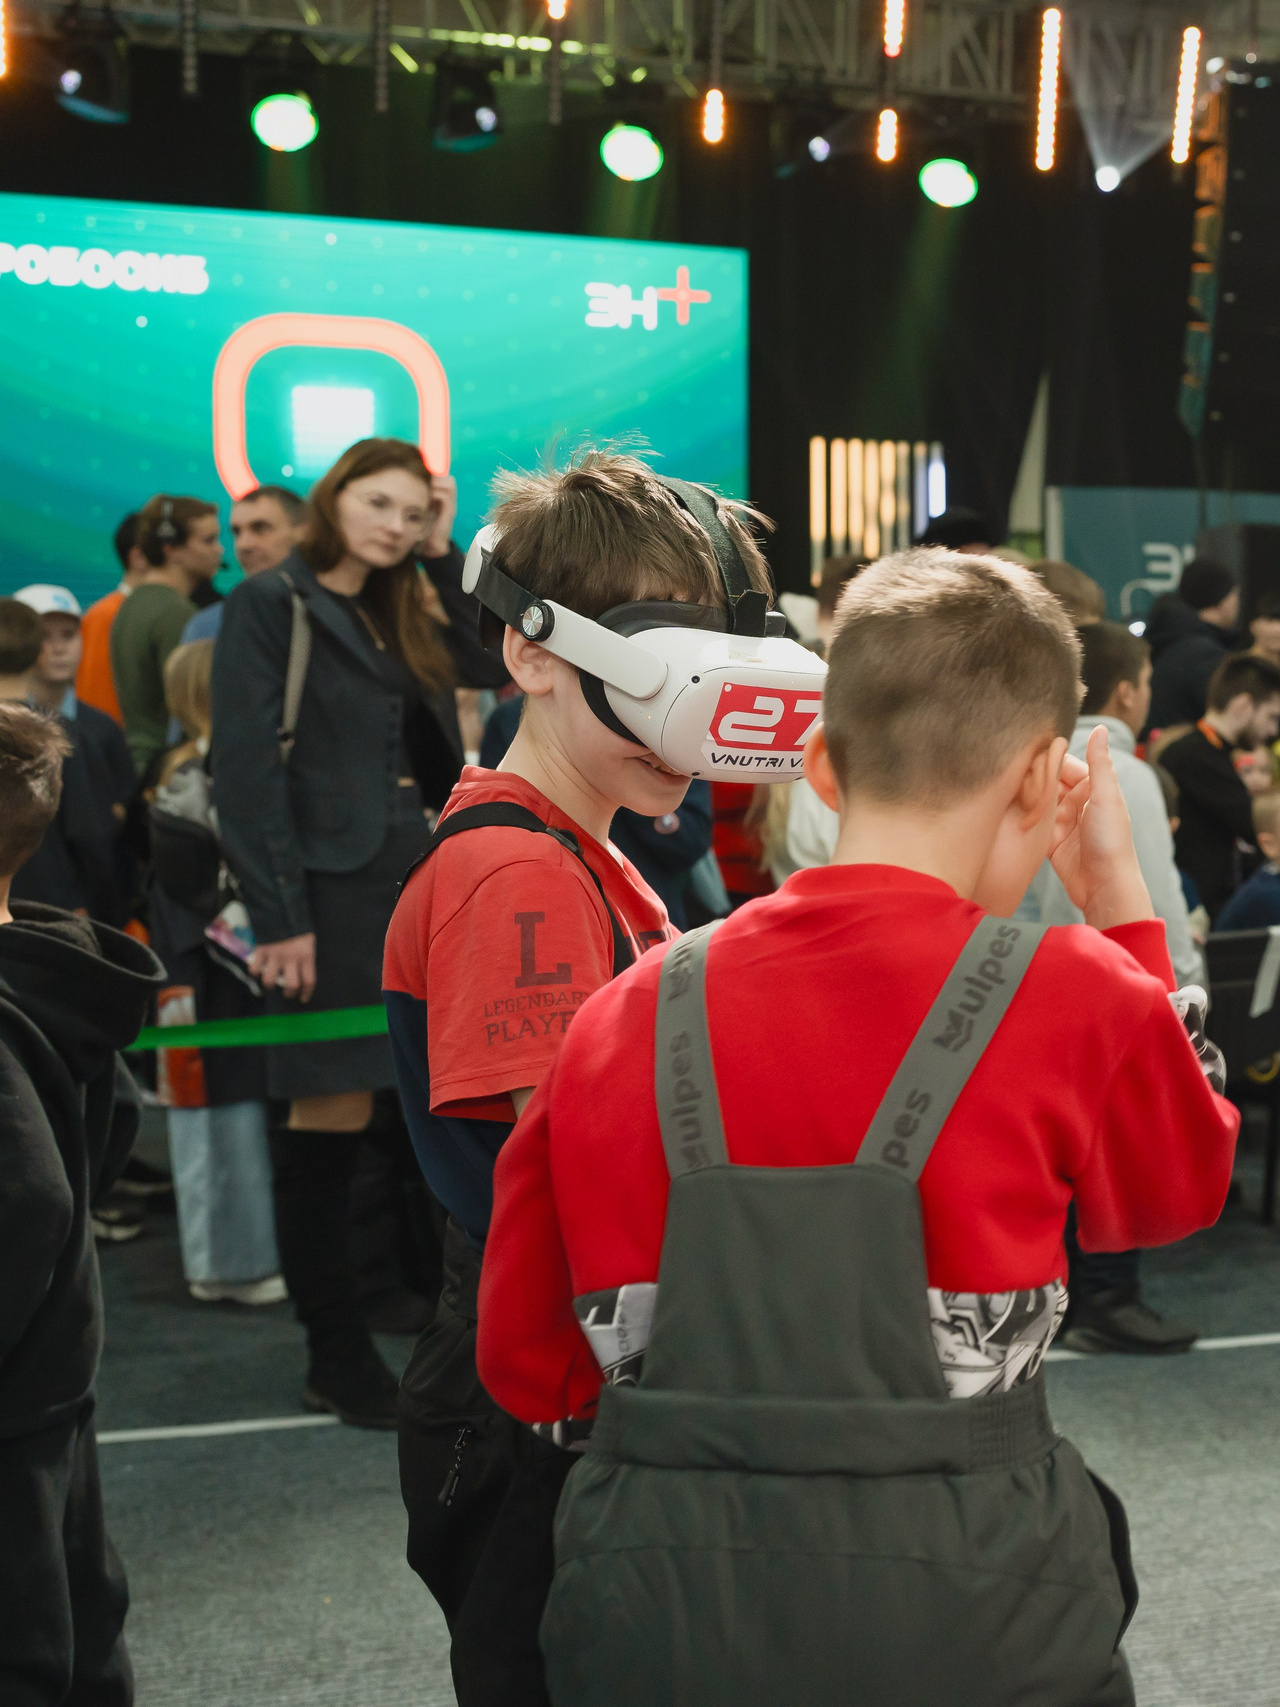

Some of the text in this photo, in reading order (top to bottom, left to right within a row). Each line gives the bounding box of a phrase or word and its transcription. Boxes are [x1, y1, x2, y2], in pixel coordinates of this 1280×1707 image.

[718, 695, 824, 746] 27
[711, 752, 804, 768] VNUTRI V
[514, 911, 572, 989] L
